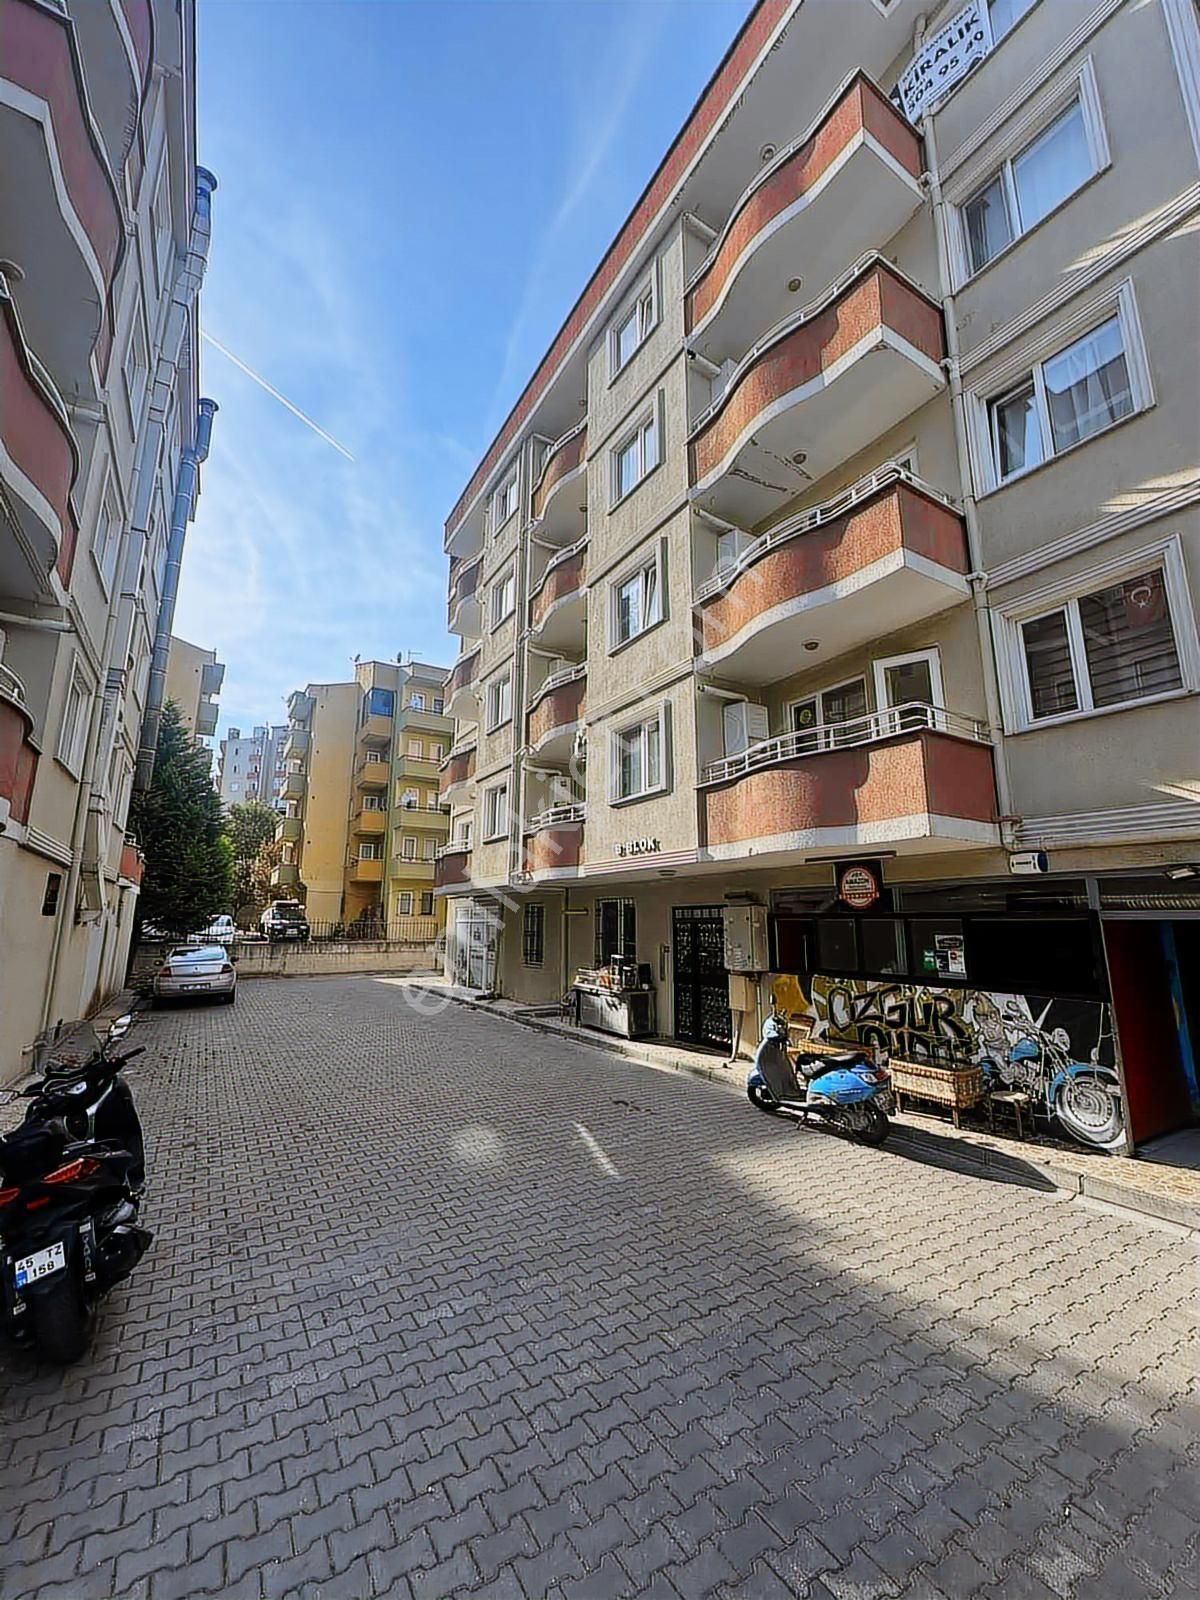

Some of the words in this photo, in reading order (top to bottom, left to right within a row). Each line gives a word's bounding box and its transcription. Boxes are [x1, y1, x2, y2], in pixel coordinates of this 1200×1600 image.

[904, 11, 980, 99] KİRALIK
[939, 56, 960, 77] 95
[46, 1244, 62, 1259] TZ
